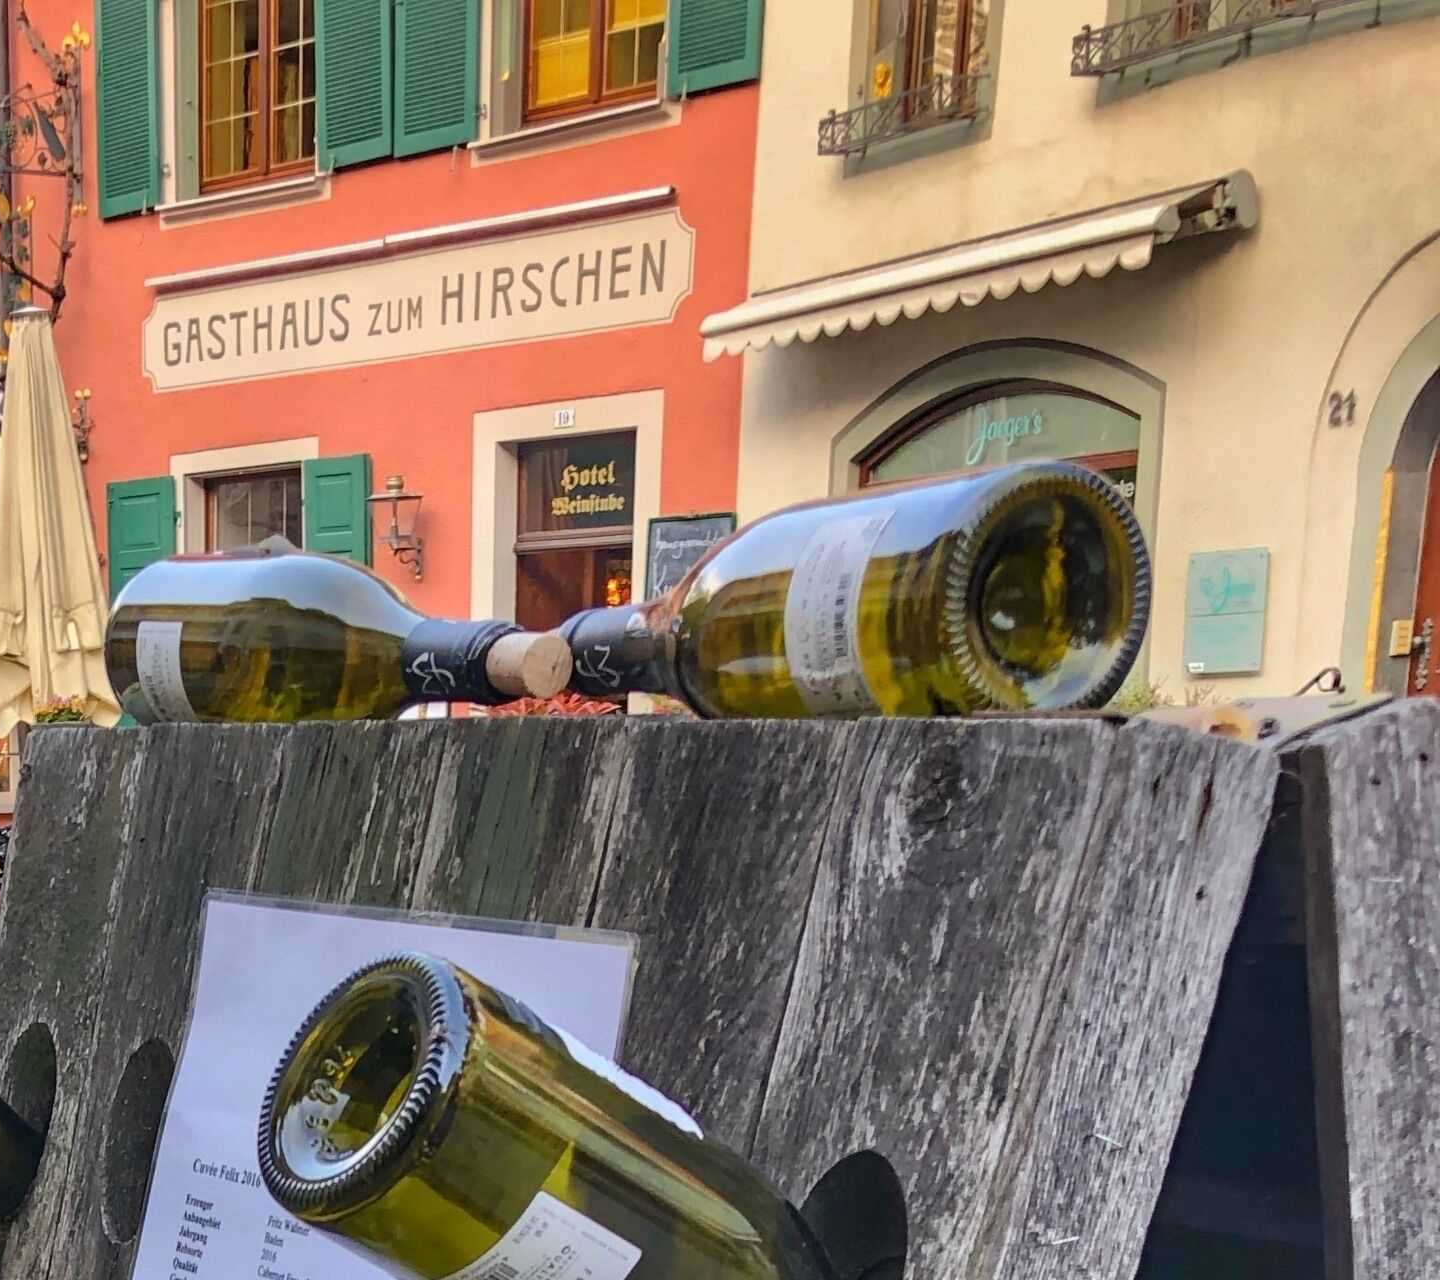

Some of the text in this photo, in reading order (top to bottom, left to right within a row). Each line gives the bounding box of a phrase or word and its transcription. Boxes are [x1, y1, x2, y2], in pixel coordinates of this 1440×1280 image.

[163, 293, 350, 366] GASTHAUS
[441, 239, 667, 326] HIRSCHEN
[557, 411, 570, 425] 19
[1329, 388, 1357, 428] 21
[561, 460, 616, 494] Hotel
[551, 493, 626, 517] Weinstube
[193, 1158, 260, 1188] Cuvée Felix 2016
[185, 1193, 214, 1211] Erzeuger
[267, 1215, 283, 1229] Fritz
[178, 1226, 208, 1246] Jahrgang
[264, 1231, 284, 1248] Baden
[172, 1256, 199, 1274] Qualität
